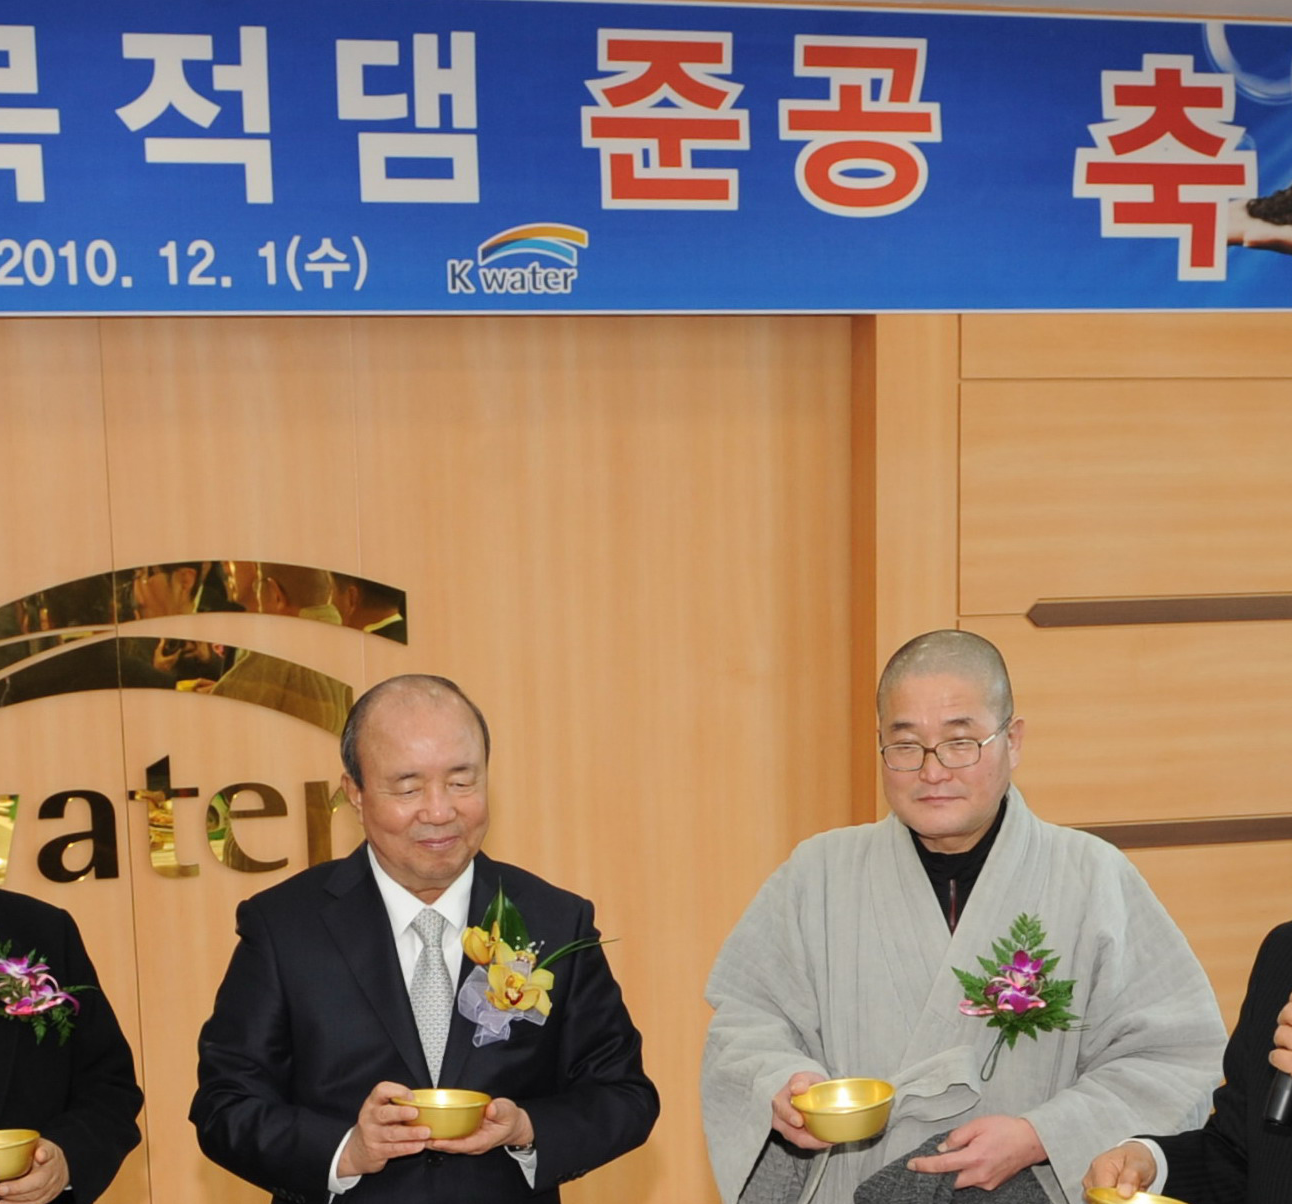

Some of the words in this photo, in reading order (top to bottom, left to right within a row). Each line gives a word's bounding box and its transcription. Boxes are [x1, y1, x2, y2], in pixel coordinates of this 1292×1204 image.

[583, 30, 940, 215] 준공
[1074, 56, 1256, 280] 축
[159, 240, 232, 288] 12.
[258, 235, 368, 291] 1(수)
